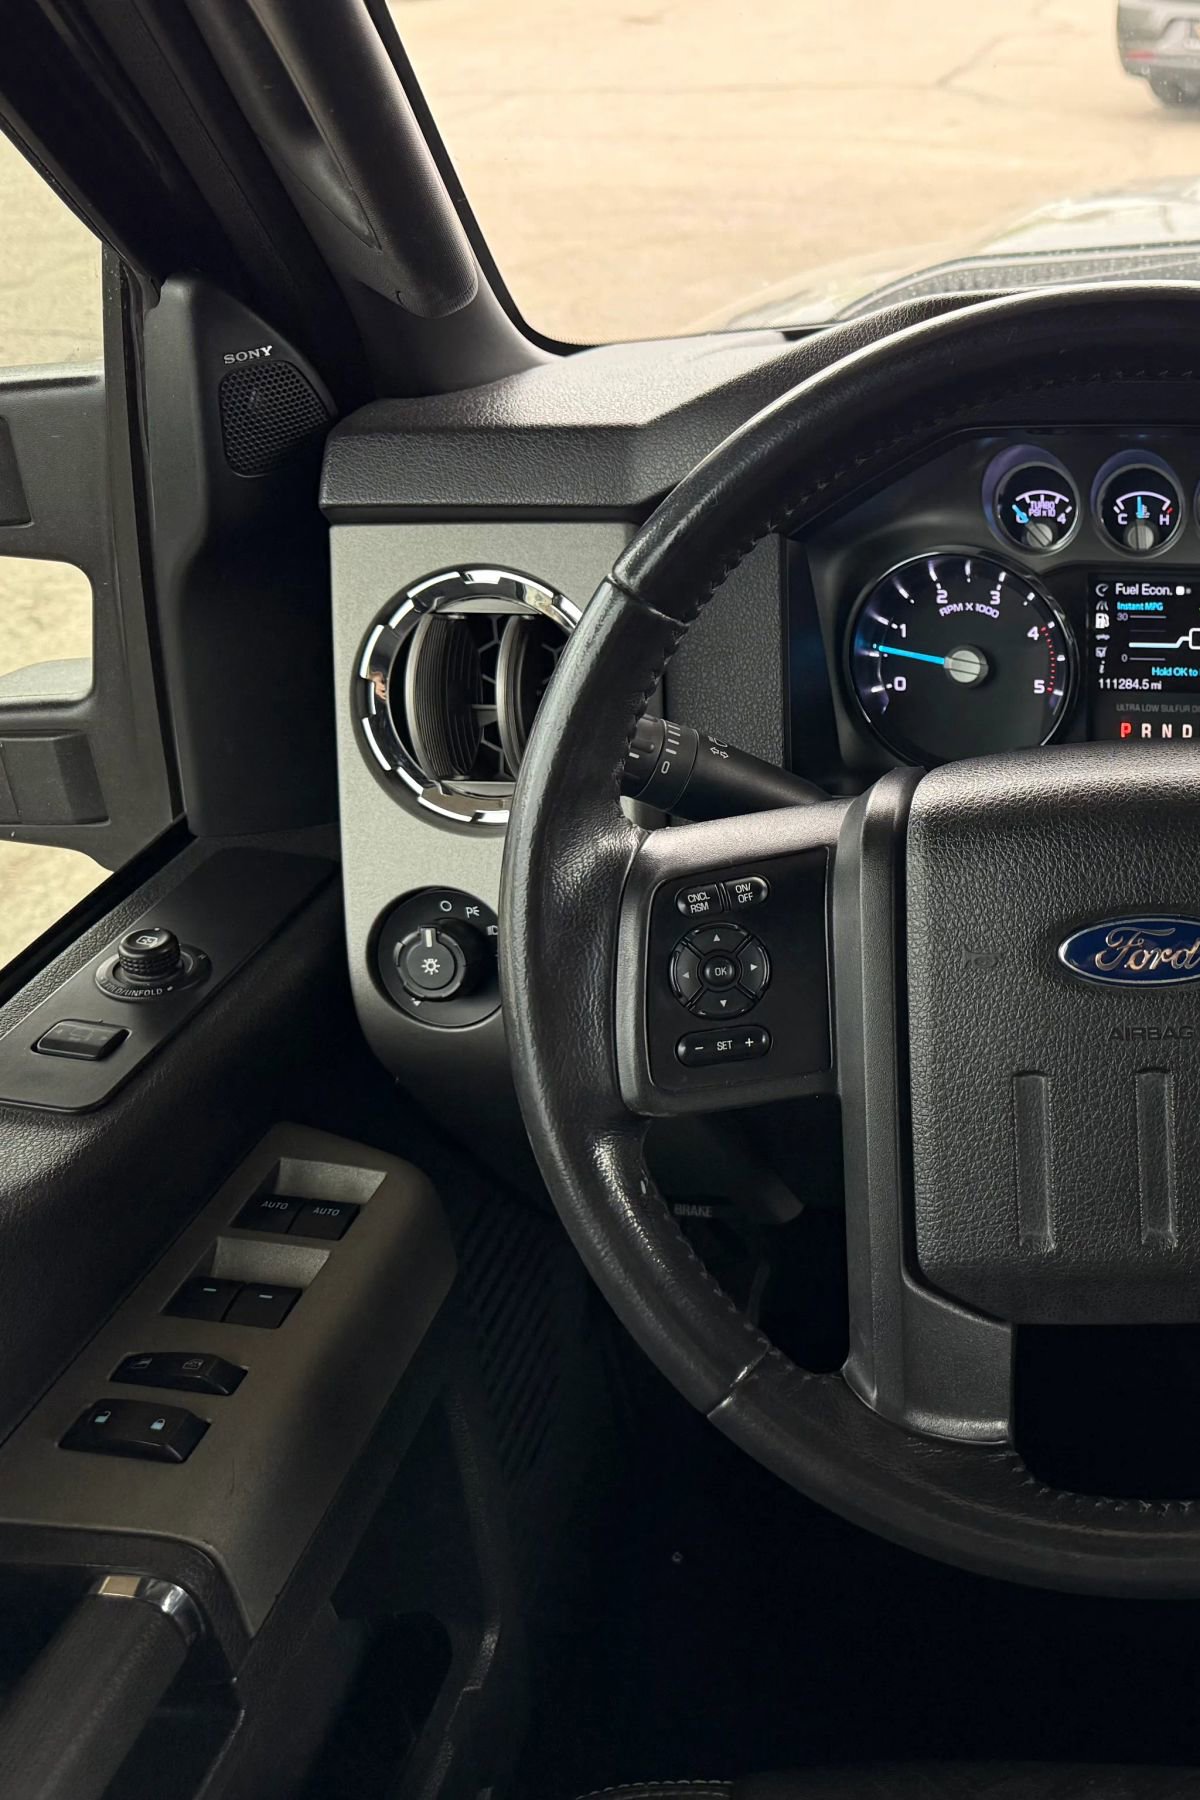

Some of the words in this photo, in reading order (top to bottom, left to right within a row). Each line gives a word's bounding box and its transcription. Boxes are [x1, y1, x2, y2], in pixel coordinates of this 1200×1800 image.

[223, 345, 273, 364] SONY
[1028, 501, 1055, 509] TURBO
[1057, 513, 1067, 524] 4
[1117, 513, 1128, 524] C
[1159, 514, 1170, 525] H
[1116, 583, 1139, 595] Fuel
[1142, 584, 1173, 595] Econ.
[936, 590, 948, 604] 2
[990, 590, 1001, 604] 3
[939, 603, 964, 616] RPM
[965, 603, 974, 611] X
[975, 604, 1000, 618] 1000
[1117, 602, 1144, 610] Instant
[1145, 602, 1164, 611] MPG
[1117, 613, 1128, 621] 30
[900, 624, 907, 637] 1
[1027, 626, 1039, 640] 4
[1121, 654, 1128, 662] 0
[1152, 667, 1173, 676] Hold
[1173, 667, 1188, 676] OK
[1189, 668, 1198, 676] to
[893, 676, 907, 691] 0
[1033, 679, 1045, 693] 5
[1098, 678, 1150, 689] 111284.5
[1150, 681, 1162, 690] mi
[1116, 703, 1140, 711] ULTRA
[1142, 704, 1159, 712] LOW
[1161, 704, 1191, 712] SULFUR
[1120, 722, 1132, 737] P
[1141, 723, 1152, 738] R
[1162, 724, 1173, 738] N
[1182, 724, 1193, 738] D
[735, 882, 751, 893] ON/
[687, 892, 711, 903] CNCL
[737, 892, 754, 903] OFF
[690, 902, 710, 913] RSM
[715, 967, 727, 976] OK
[1107, 1025, 1194, 1040] AIRBAG
[717, 1040, 733, 1050] SET
[262, 1200, 289, 1209] AUTO
[674, 1203, 713, 1217] BRAKE
[313, 1207, 340, 1216] AUTO
